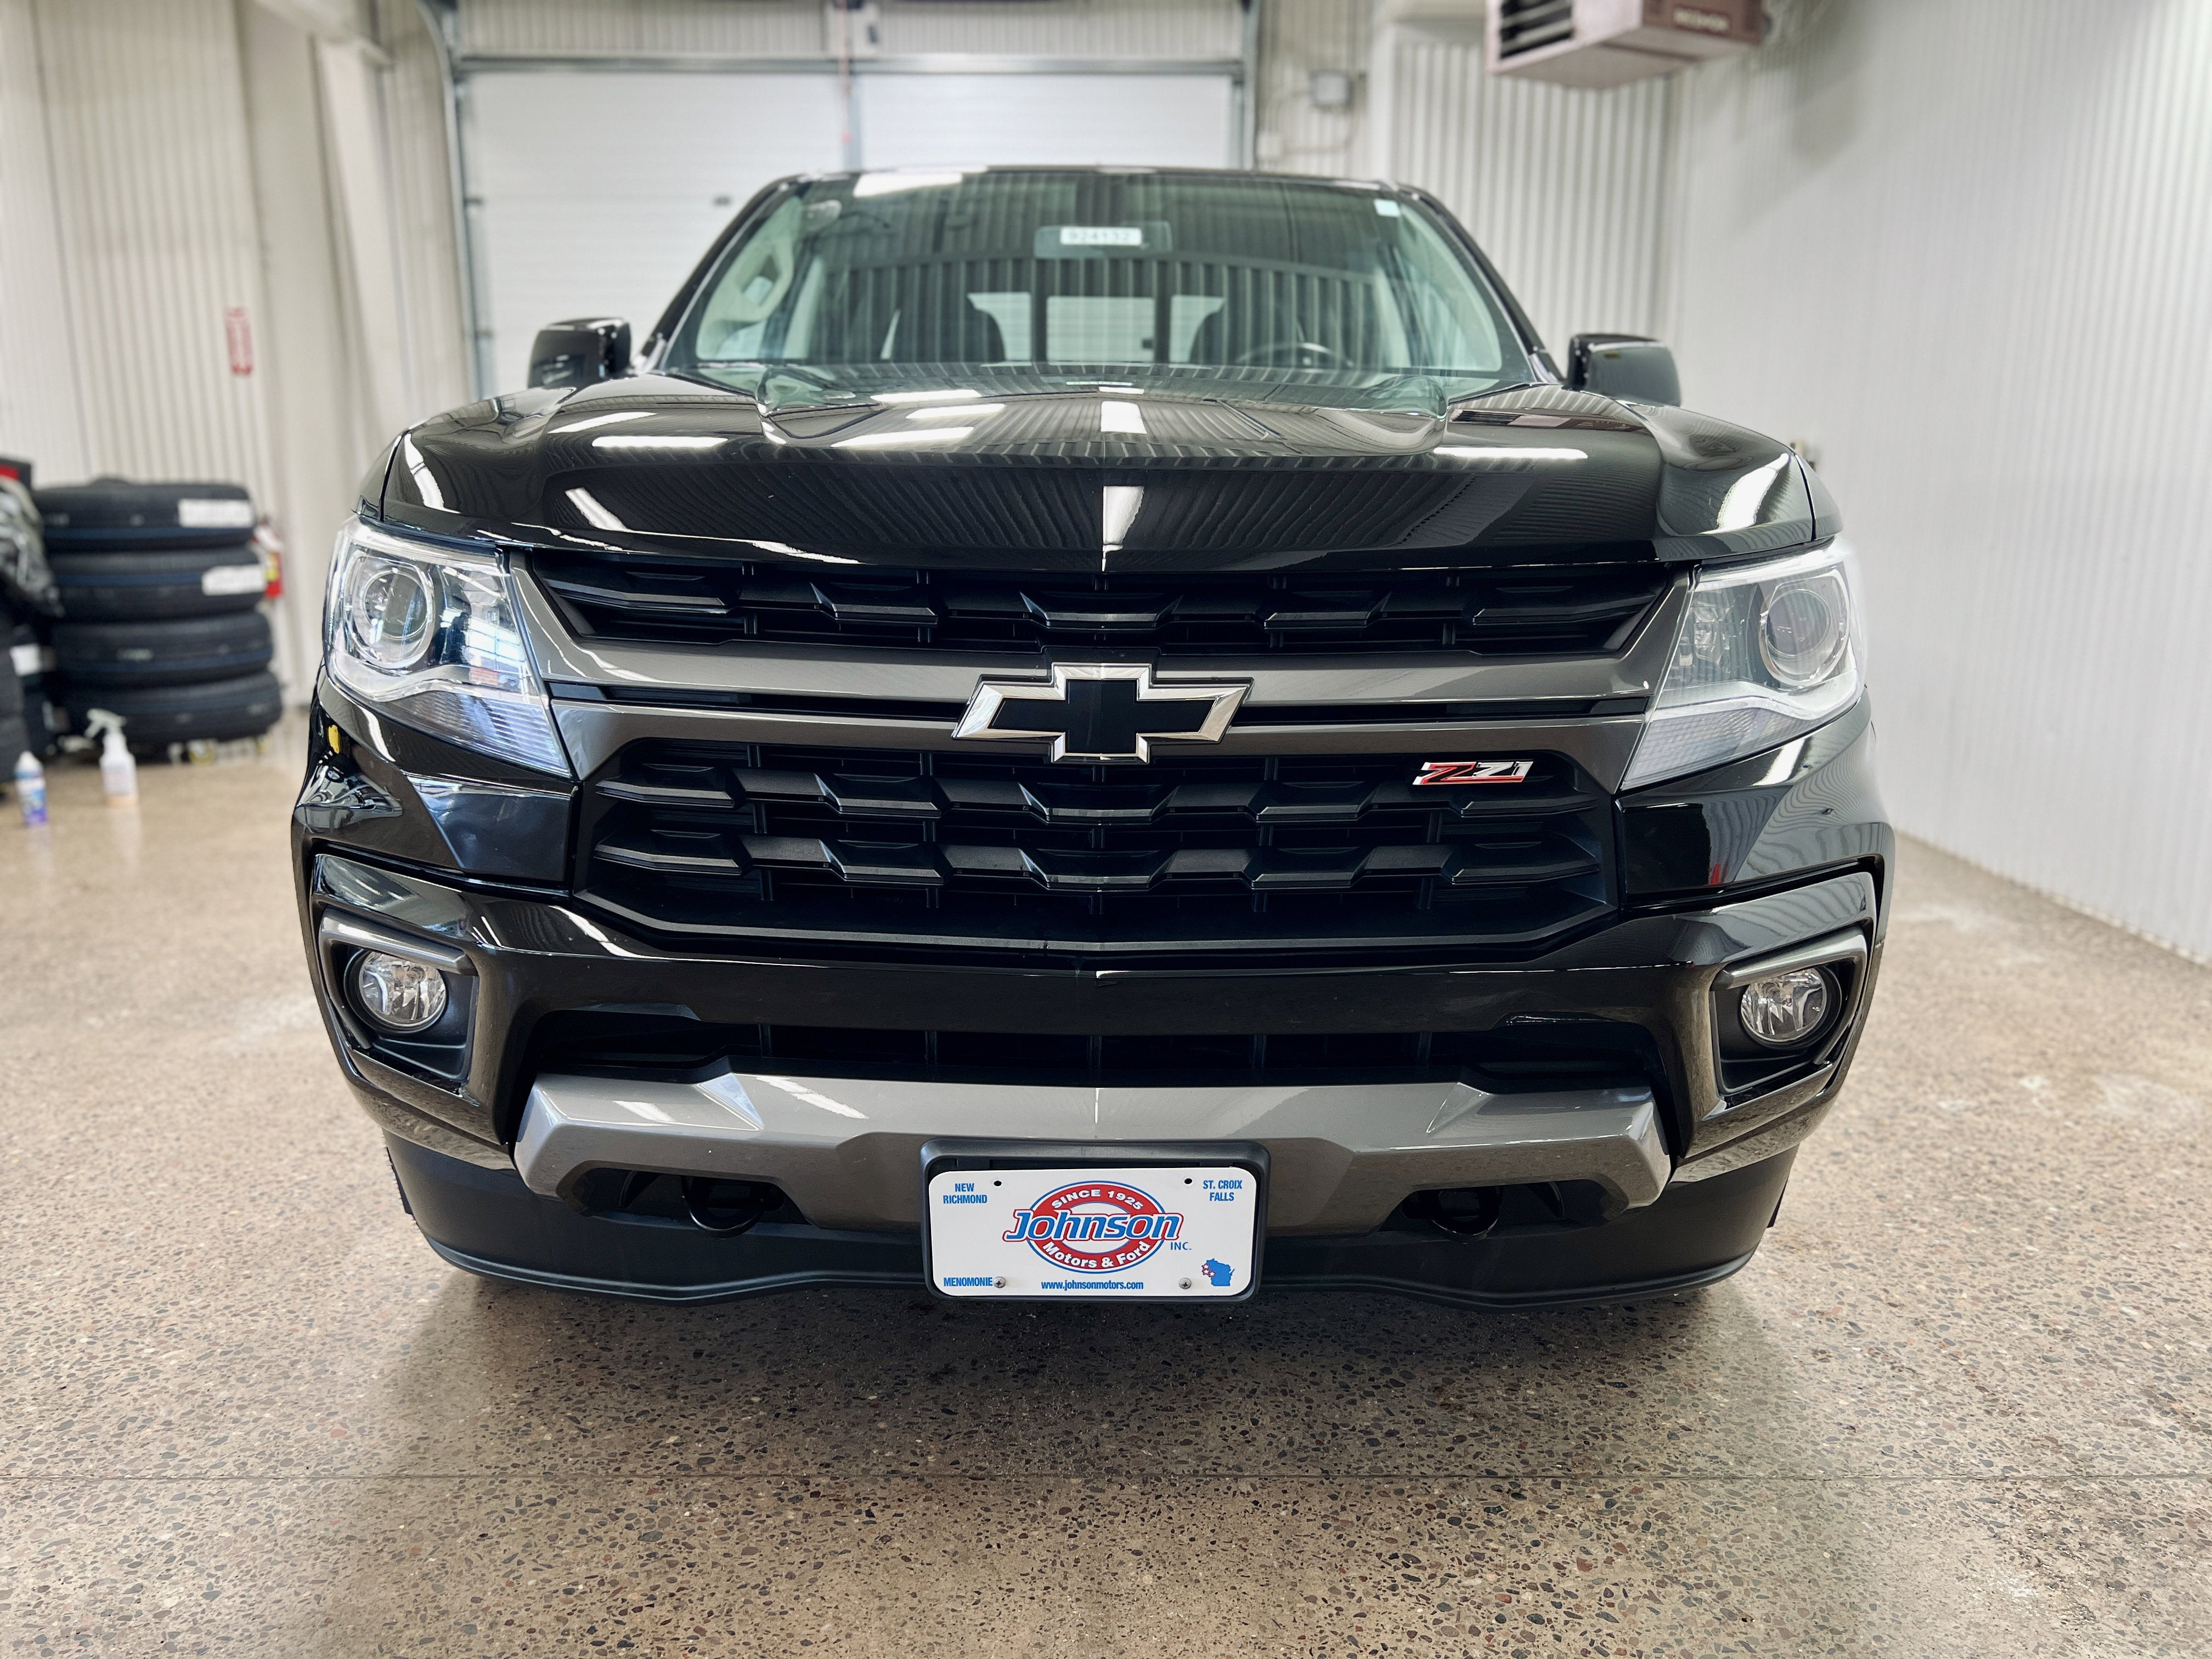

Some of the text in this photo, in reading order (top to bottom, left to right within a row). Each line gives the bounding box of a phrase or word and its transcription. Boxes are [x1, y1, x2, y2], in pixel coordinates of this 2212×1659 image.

[1412, 761, 1533, 785] Z71
[955, 1183, 974, 1192] NEW
[1203, 1180, 1243, 1189] ST. CROIX
[943, 1194, 988, 1204] RICHMOND
[1051, 1189, 1144, 1210] SINCE 1925
[1209, 1192, 1234, 1201] FALLS
[1004, 1209, 1182, 1240] Johnson
[1170, 1242, 1192, 1250] INC.
[1042, 1240, 1151, 1268] Motors & Ford
[943, 1277, 993, 1287] MENOMONIE
[1041, 1280, 1144, 1291] www.johnsonmotors.com
